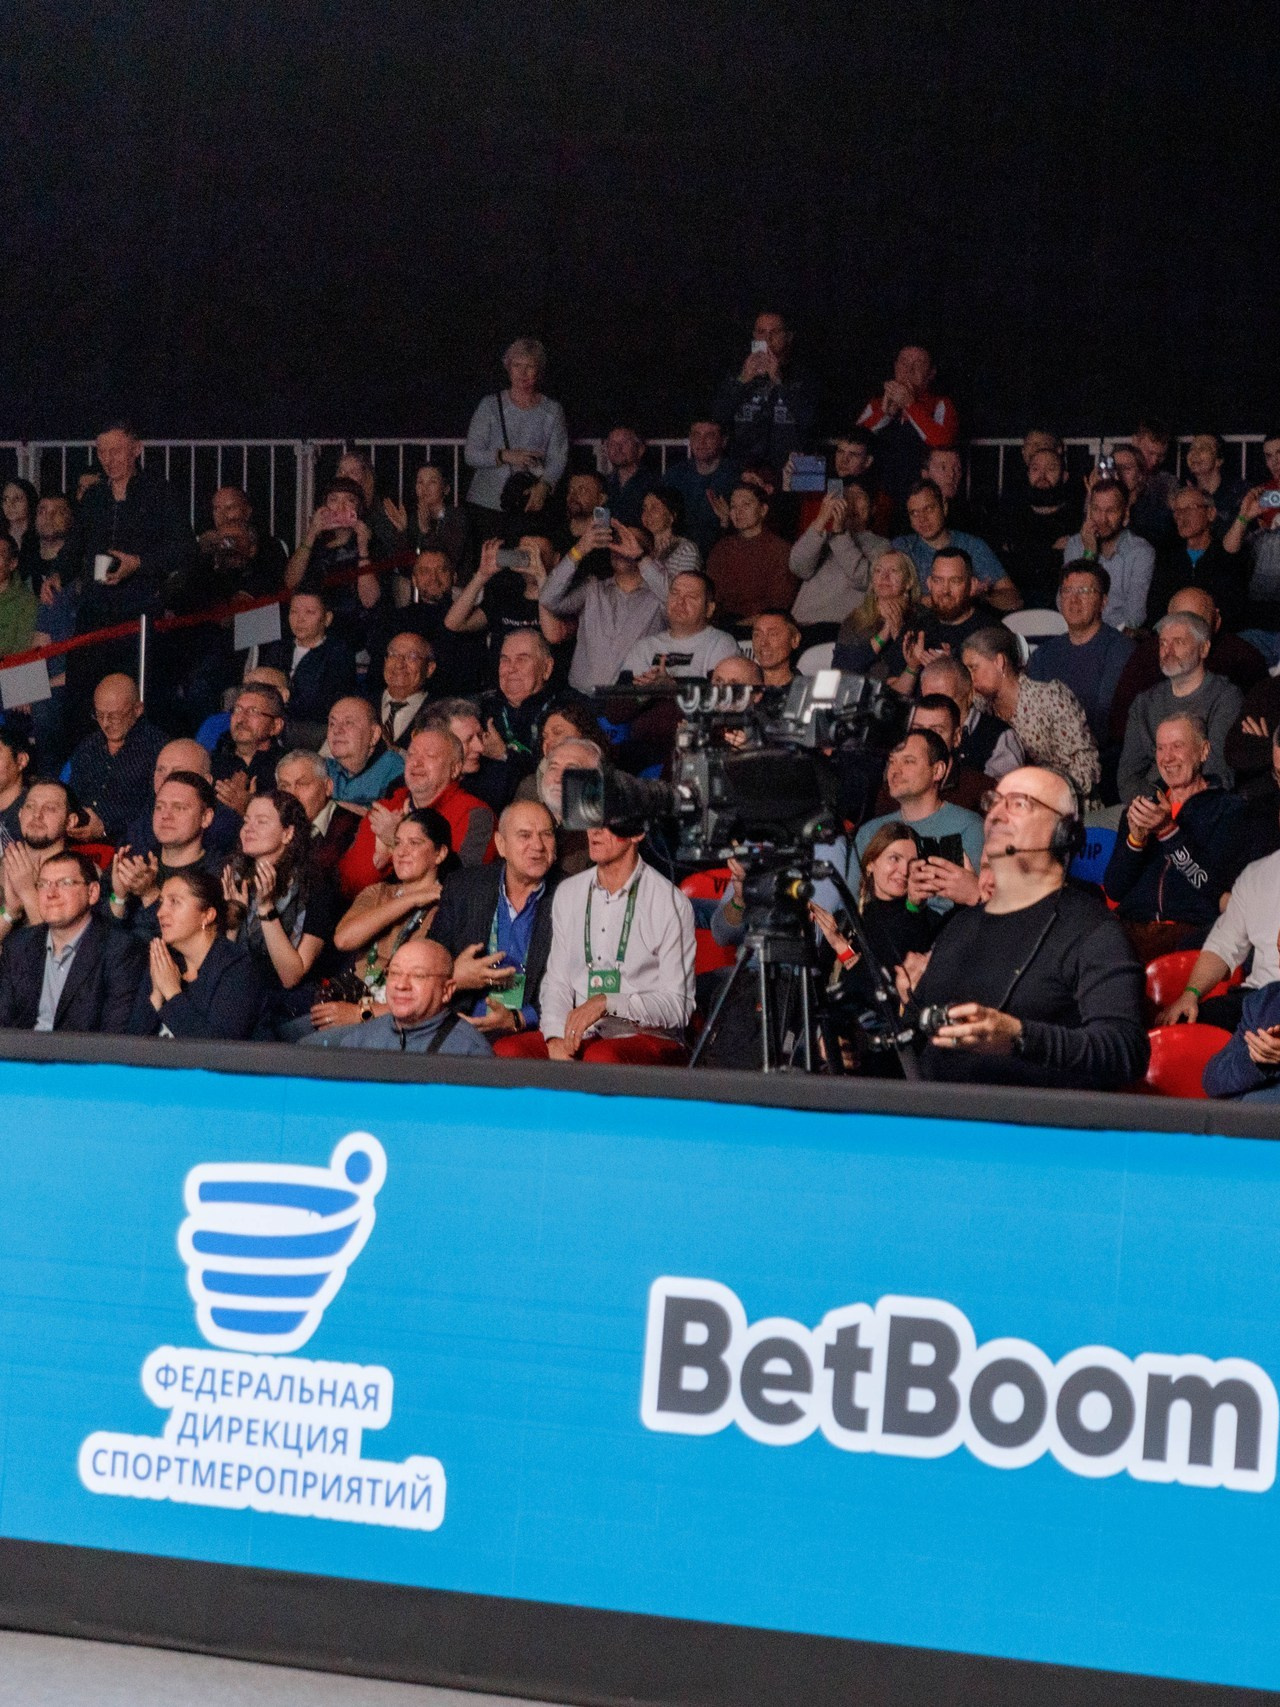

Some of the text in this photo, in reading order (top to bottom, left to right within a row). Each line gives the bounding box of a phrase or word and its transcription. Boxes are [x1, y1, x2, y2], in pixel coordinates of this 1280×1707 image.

[155, 1363, 380, 1411] ФЕДЕРАЛЬНАЯ
[656, 1295, 1263, 1472] BetBoom
[176, 1412, 349, 1458] ДИРЕКЦИЯ
[92, 1448, 433, 1512] СПОРТМЕРОПРИЯТИЙ
